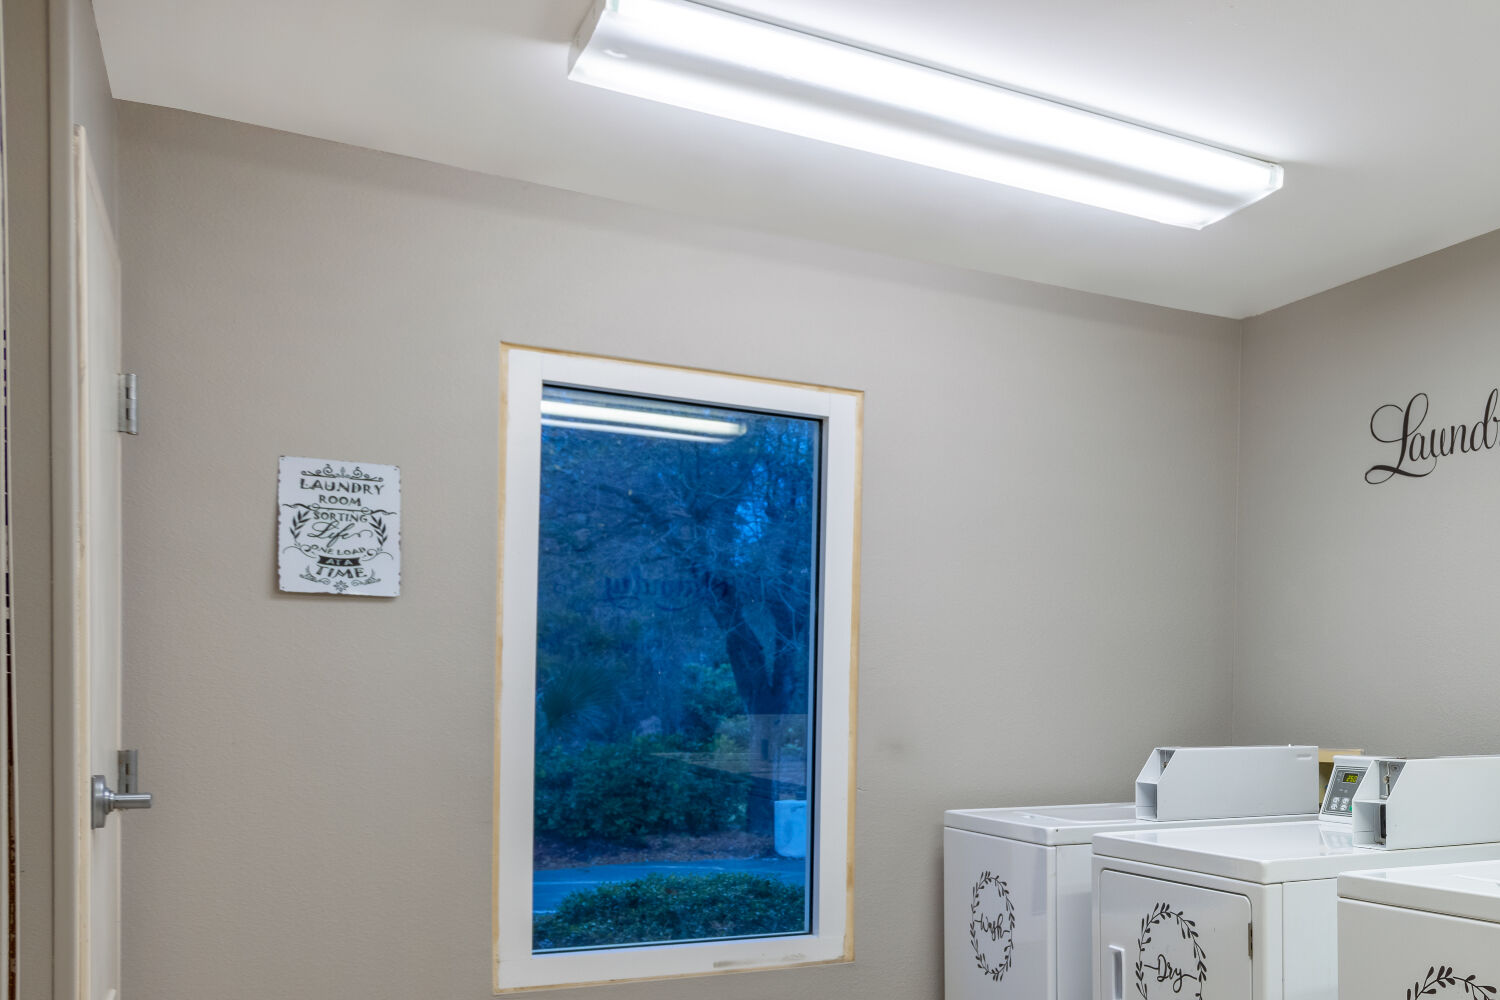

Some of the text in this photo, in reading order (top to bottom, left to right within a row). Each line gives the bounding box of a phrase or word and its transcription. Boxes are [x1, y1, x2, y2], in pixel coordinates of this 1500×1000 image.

[300, 478, 385, 495] LAUNDRY
[318, 494, 362, 507] ROOM
[313, 511, 368, 523] SORTING
[307, 521, 374, 548] Life
[310, 544, 366, 556] ONE LOAD
[315, 565, 367, 579] TIME
[974, 913, 1010, 941] Wash
[1144, 954, 1197, 993] Dry
